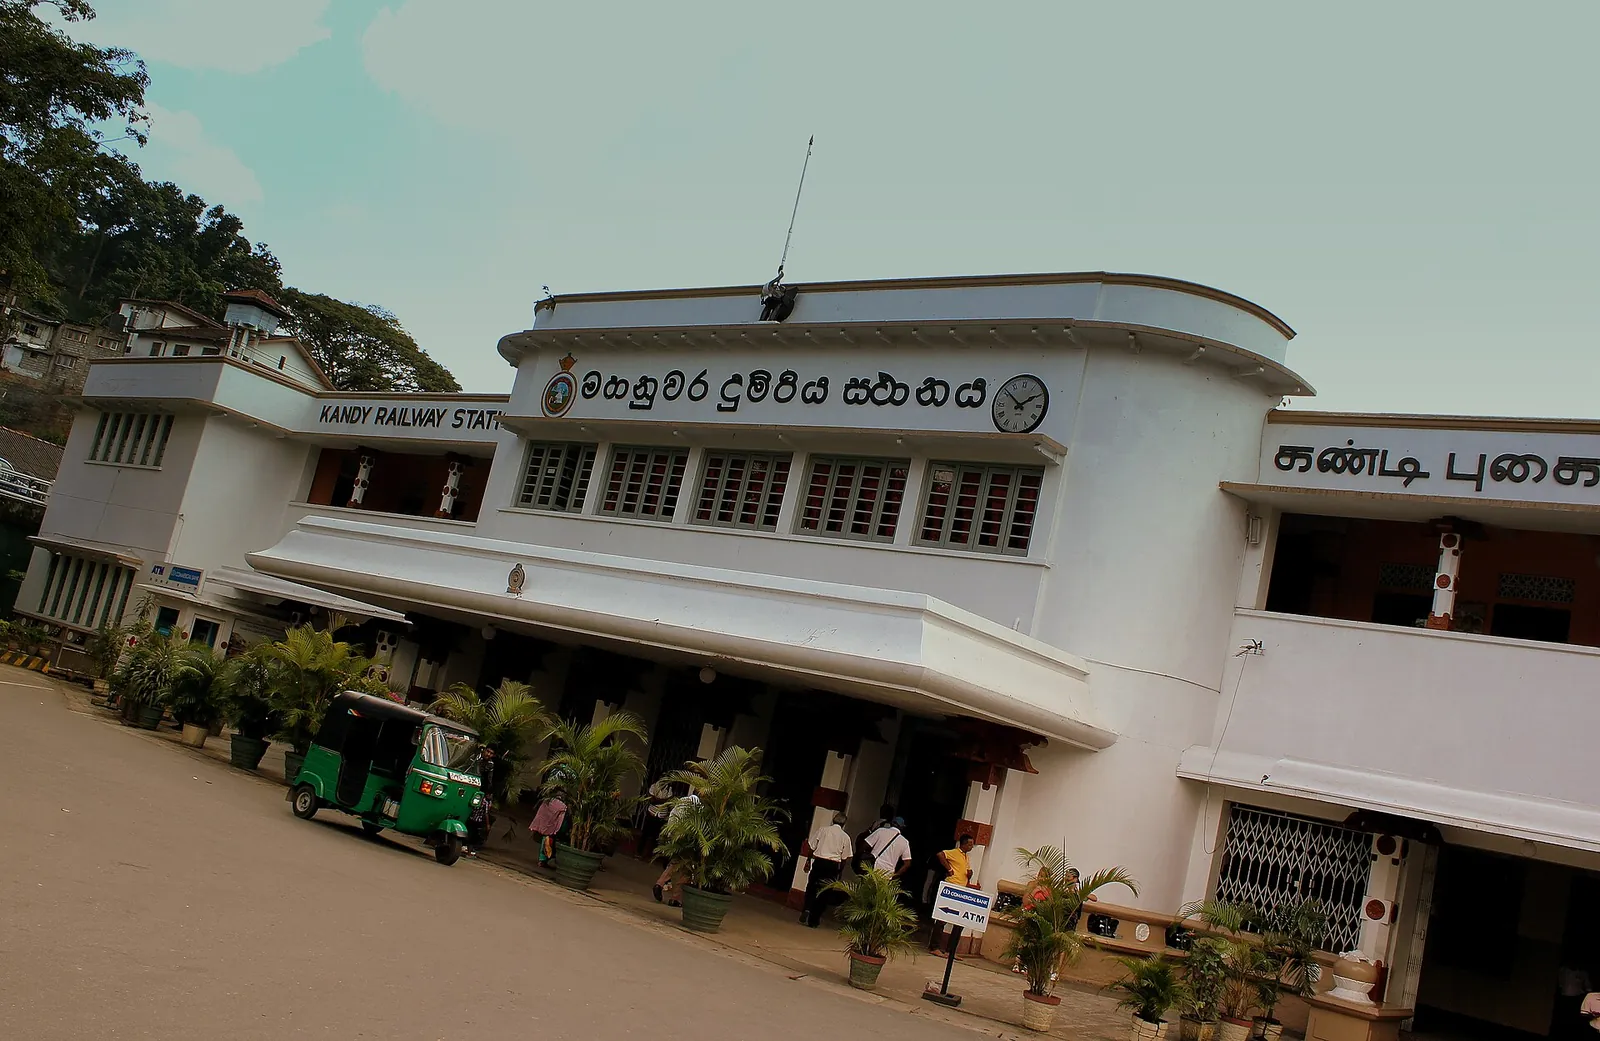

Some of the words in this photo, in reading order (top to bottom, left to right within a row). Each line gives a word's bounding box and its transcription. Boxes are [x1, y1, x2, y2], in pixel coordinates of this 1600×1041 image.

[581, 368, 709, 410] මහනුවර
[319, 404, 373, 424] KANDY
[374, 406, 448, 428] RAILWAY
[451, 408, 507, 431] STATI
[1274, 438, 1430, 488] கண்டி
[951, 892, 976, 902] COMMERCIAL
[977, 898, 988, 906] BANK
[962, 912, 985, 924] ATM
